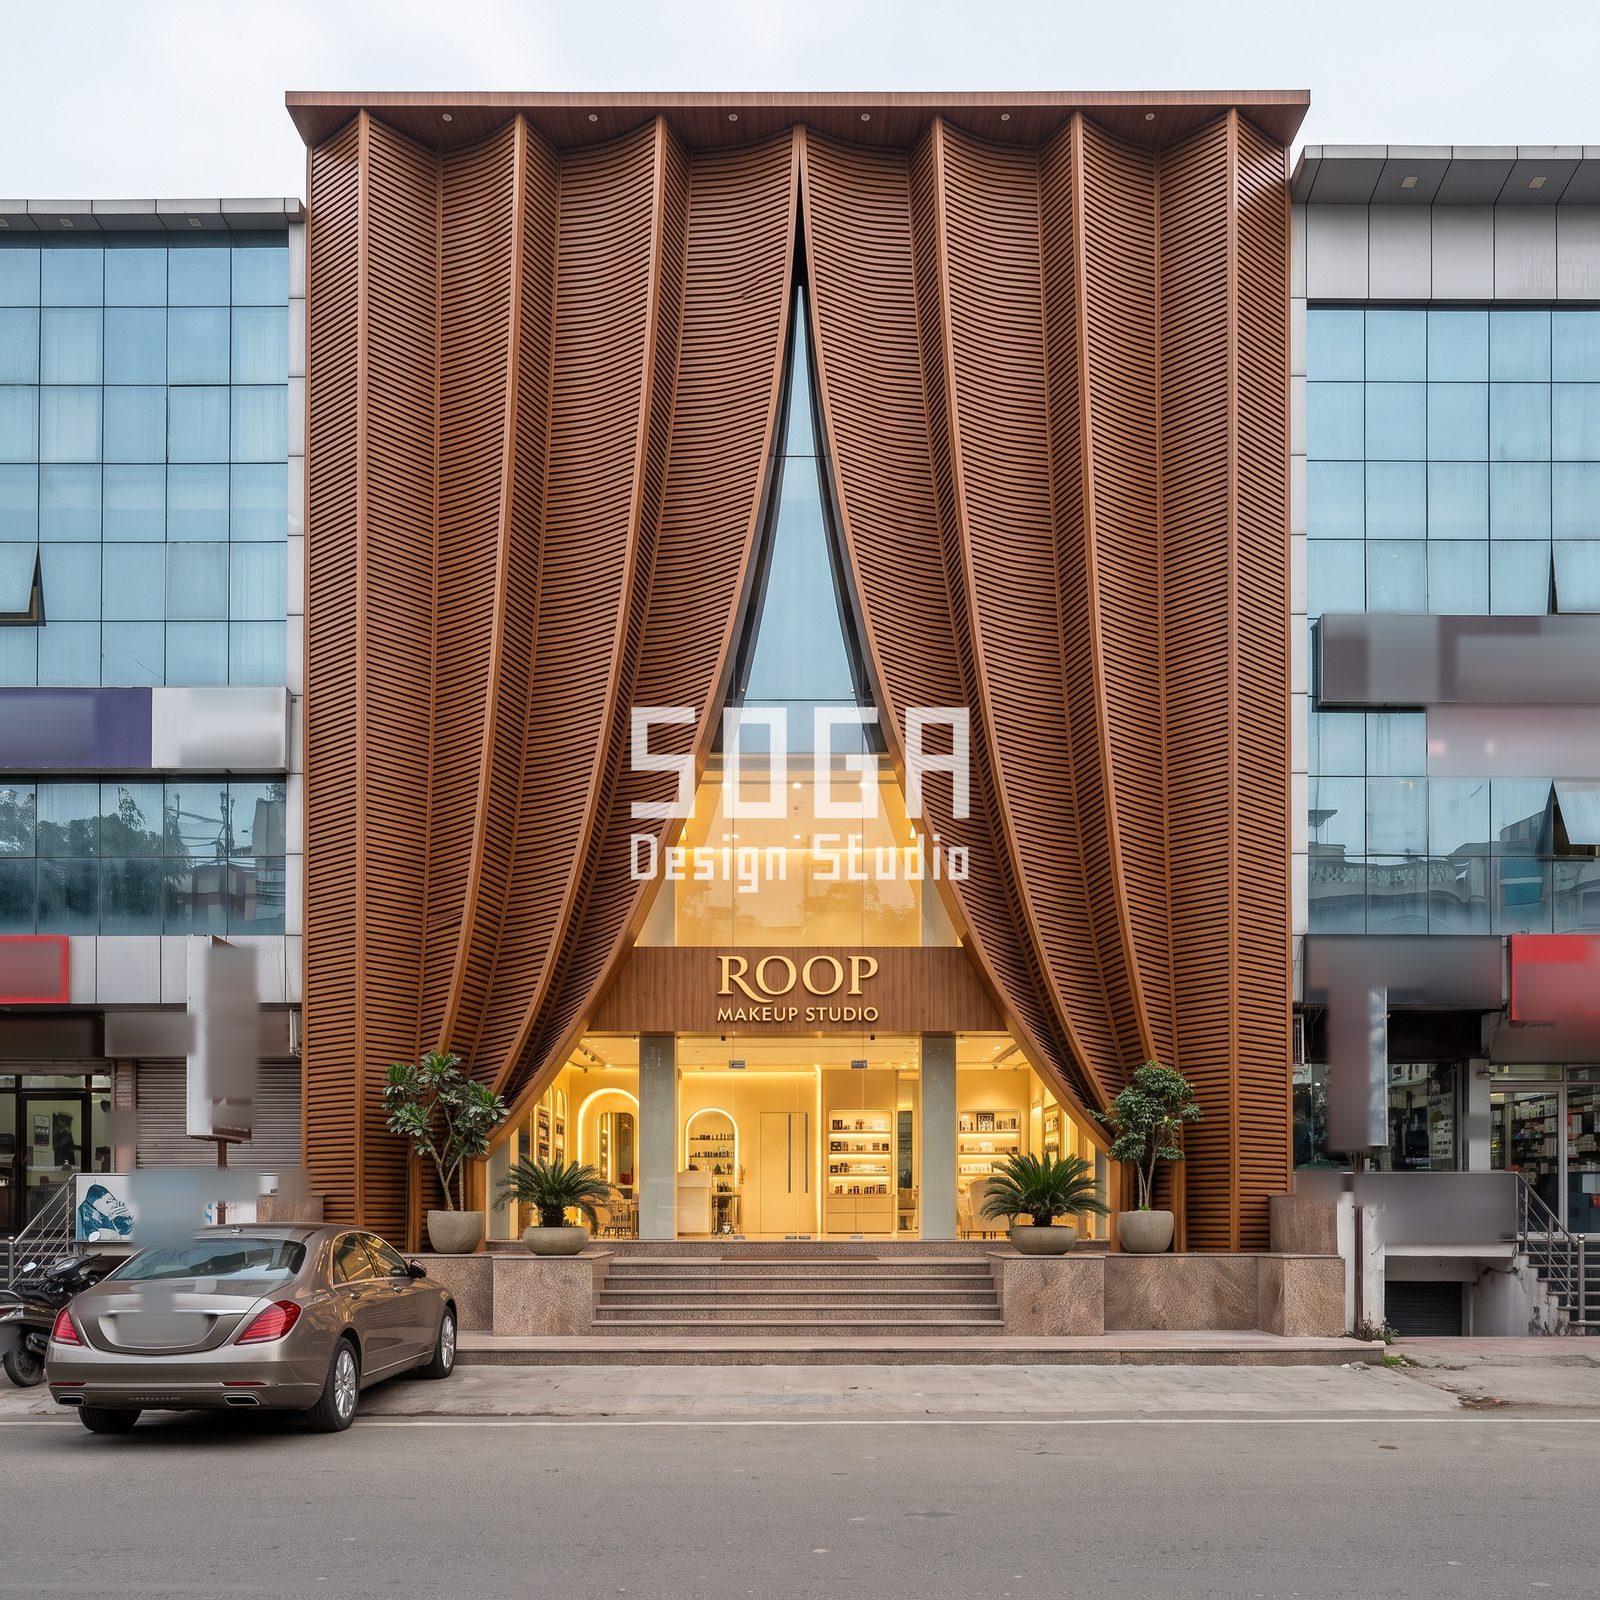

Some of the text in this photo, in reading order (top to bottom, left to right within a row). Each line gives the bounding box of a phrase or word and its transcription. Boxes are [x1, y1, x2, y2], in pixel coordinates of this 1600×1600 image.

[717, 955, 879, 1003] ROOP
[717, 1006, 879, 1022] MAKEUP STUDIO
